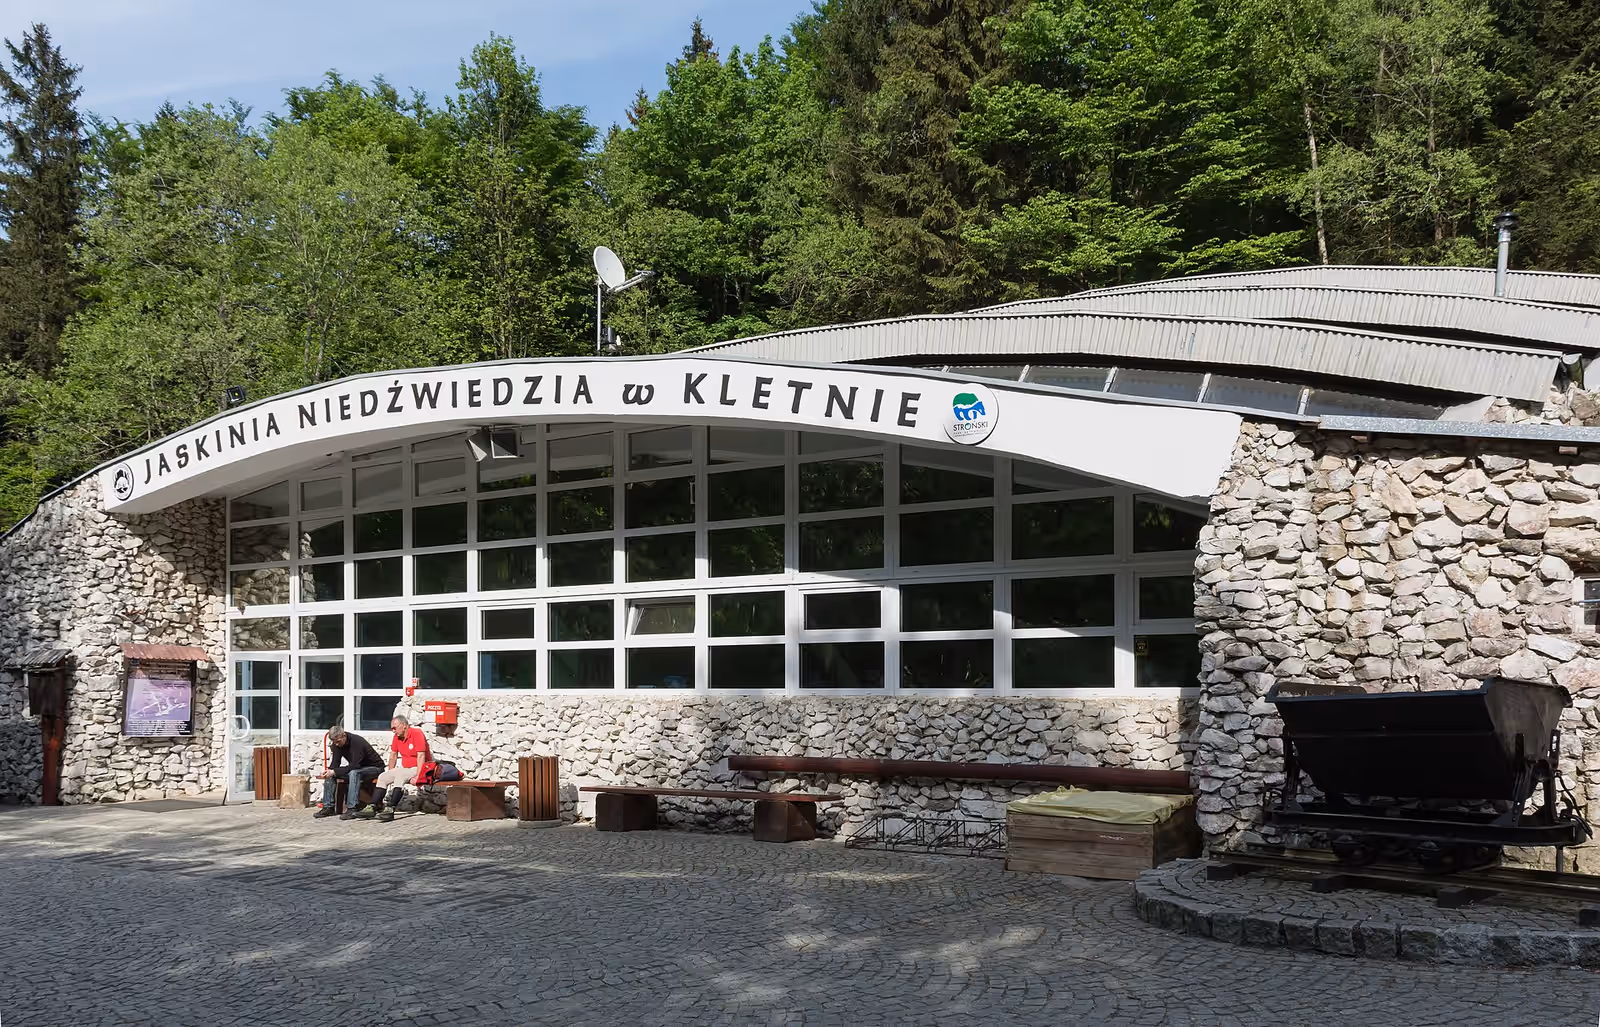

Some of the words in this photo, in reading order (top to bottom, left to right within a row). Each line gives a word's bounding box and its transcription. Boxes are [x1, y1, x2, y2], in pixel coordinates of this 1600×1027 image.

[144, 412, 281, 485] JASKINIA
[297, 374, 593, 429] NIEDŹWIEDZIA
[683, 372, 922, 428] KLETNIE
